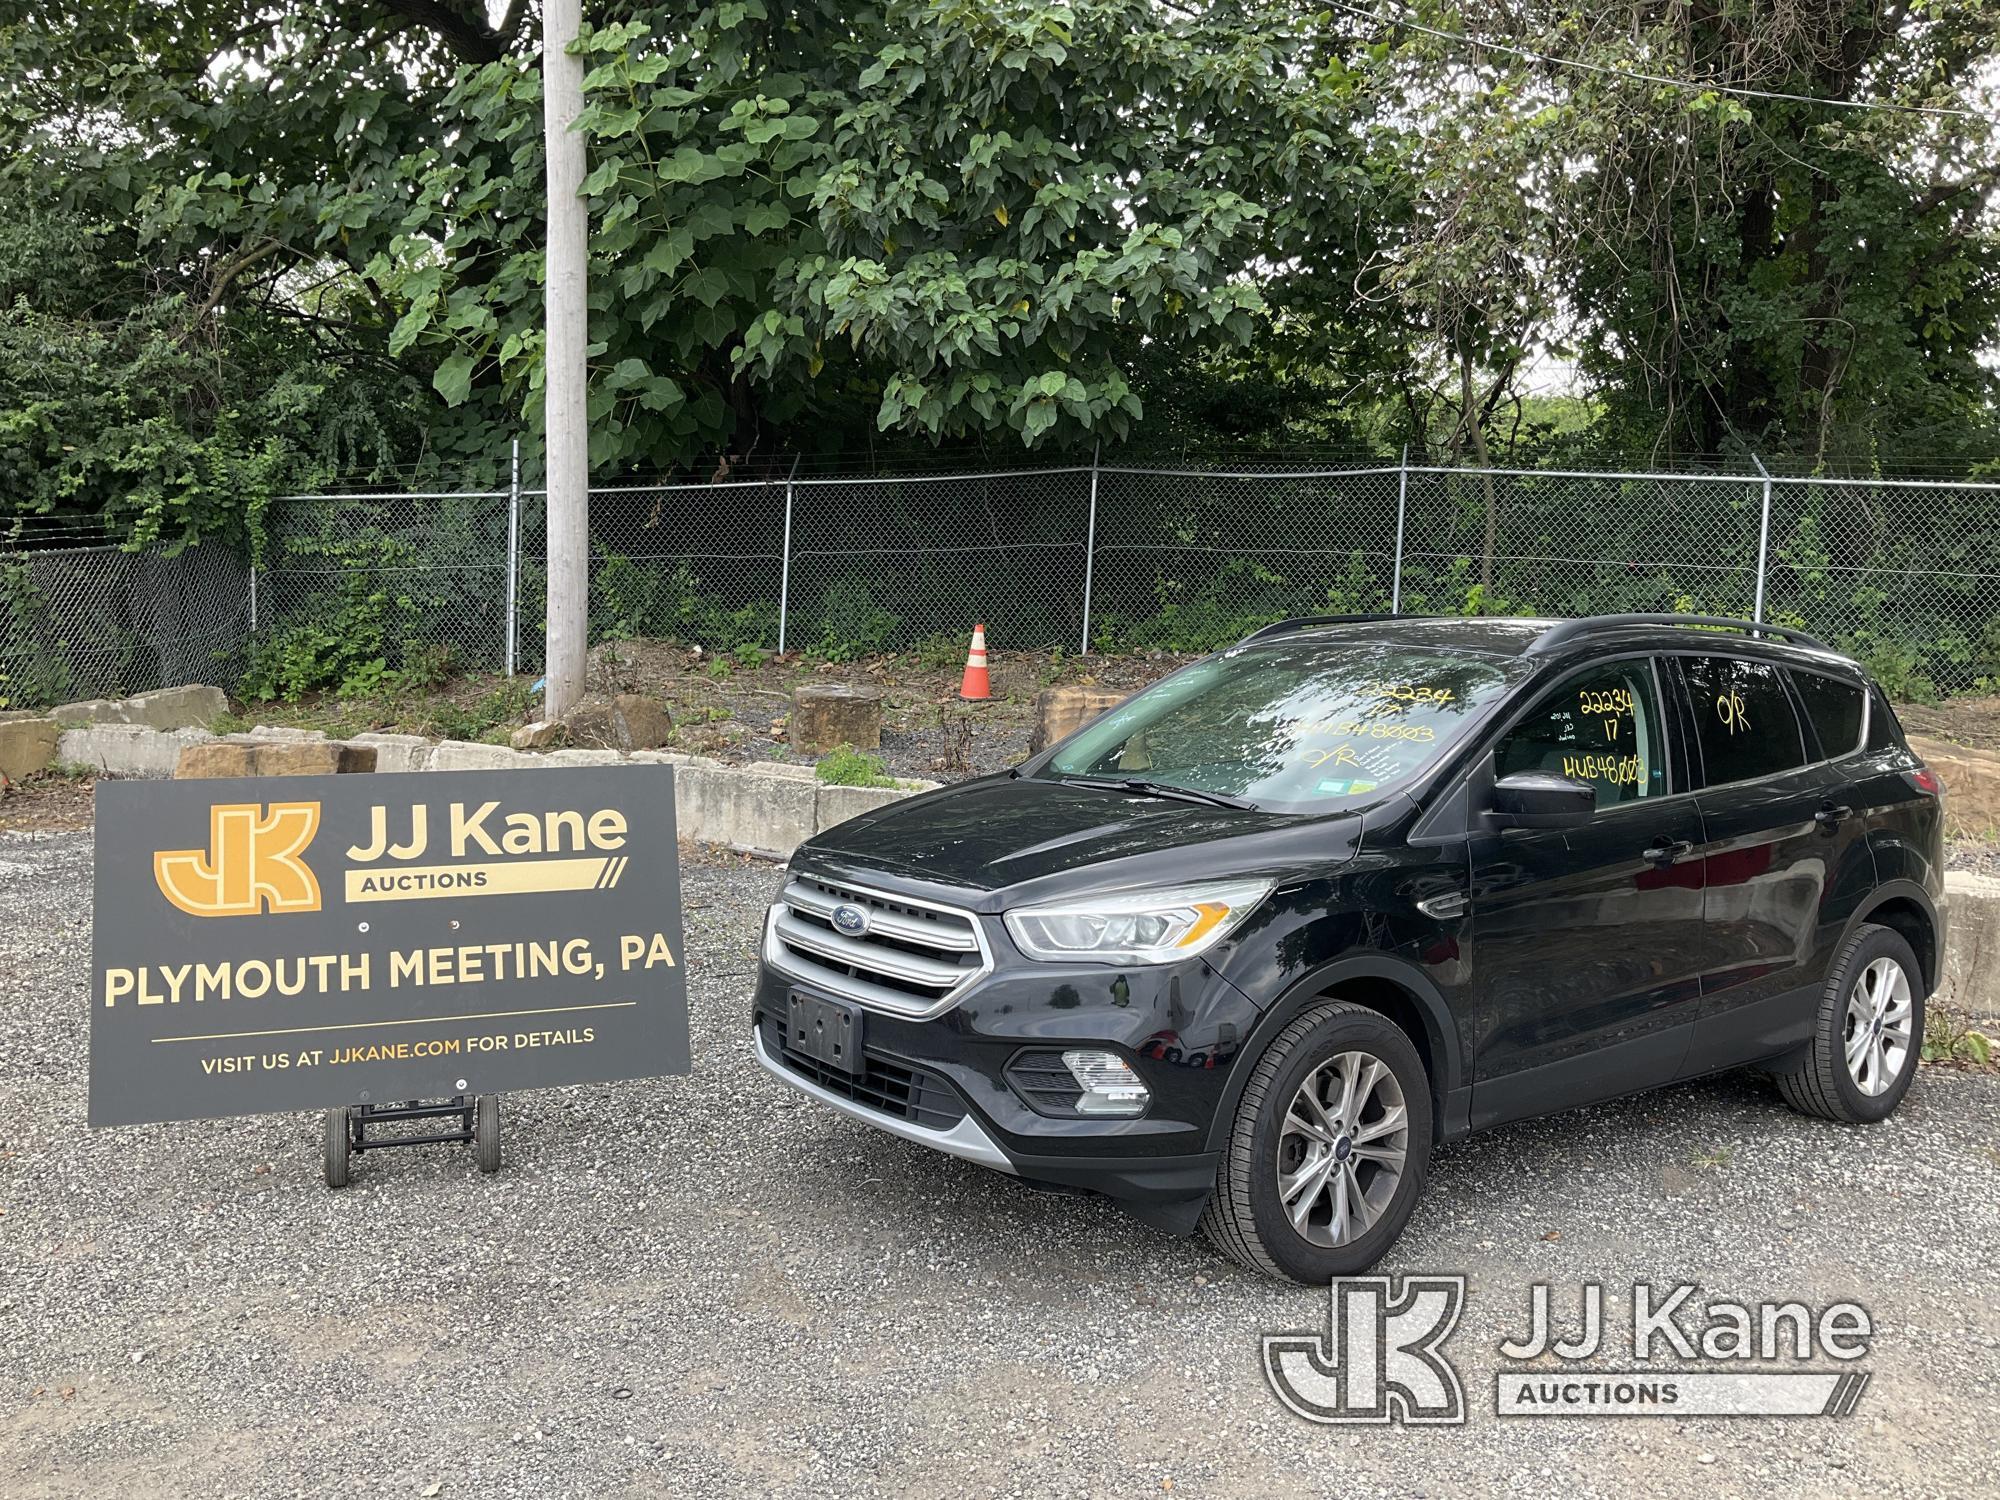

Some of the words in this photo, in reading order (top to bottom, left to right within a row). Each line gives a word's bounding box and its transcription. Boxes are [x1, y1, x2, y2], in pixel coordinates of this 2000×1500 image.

[1580, 688, 1635, 717] 22234
[1716, 690, 1751, 735] O/R
[1603, 719, 1618, 742] 17
[1301, 744, 1360, 769] O/R
[345, 804, 428, 862] JJ
[452, 802, 628, 855] Kane
[361, 871, 488, 893] AUCTIONS
[836, 910, 859, 928] Ford
[105, 952, 370, 1007] PLYMOUTH
[390, 938, 605, 988] MEETING,
[620, 933, 676, 970] PA
[202, 1055, 253, 1075] VISIT
[262, 1052, 290, 1070] US
[296, 1050, 324, 1067] AT
[329, 1039, 461, 1065] JJKANE.COM
[467, 1034, 509, 1053] FOR
[515, 1028, 595, 1050] DETAILS
